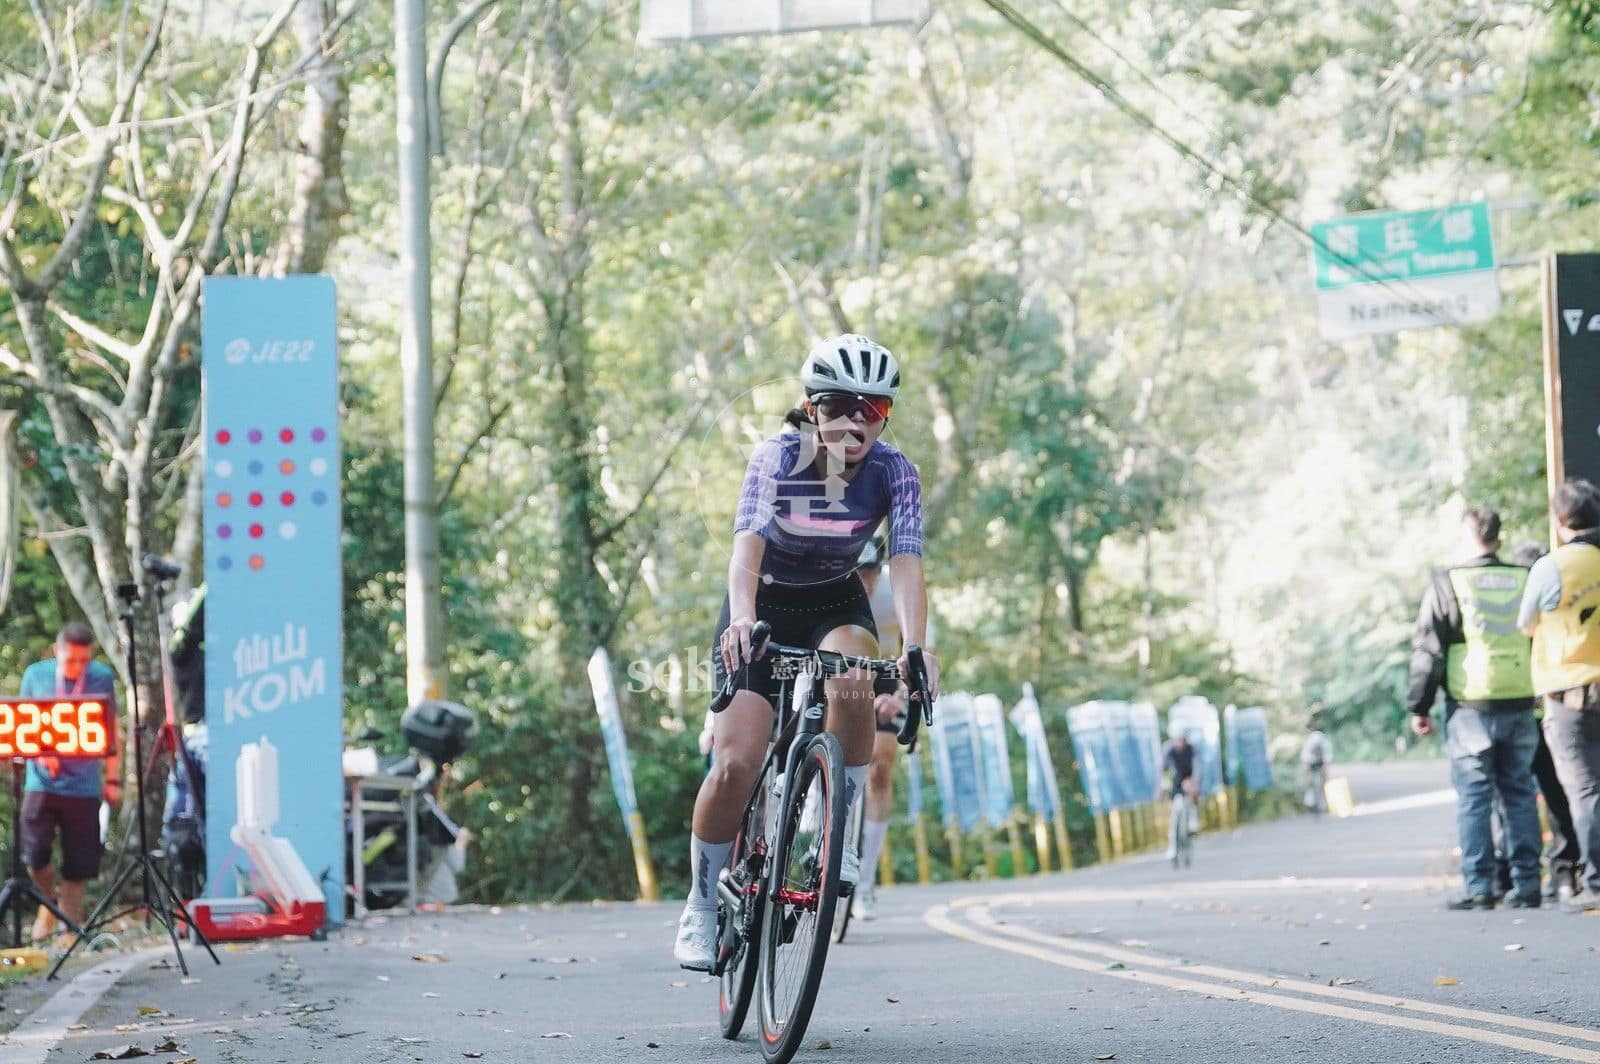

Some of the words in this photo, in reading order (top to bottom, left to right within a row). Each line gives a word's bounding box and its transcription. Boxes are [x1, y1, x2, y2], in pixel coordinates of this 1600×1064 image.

[233, 623, 307, 679] 仙山
[223, 656, 326, 724] KOM
[0, 703, 106, 753] 22:56
